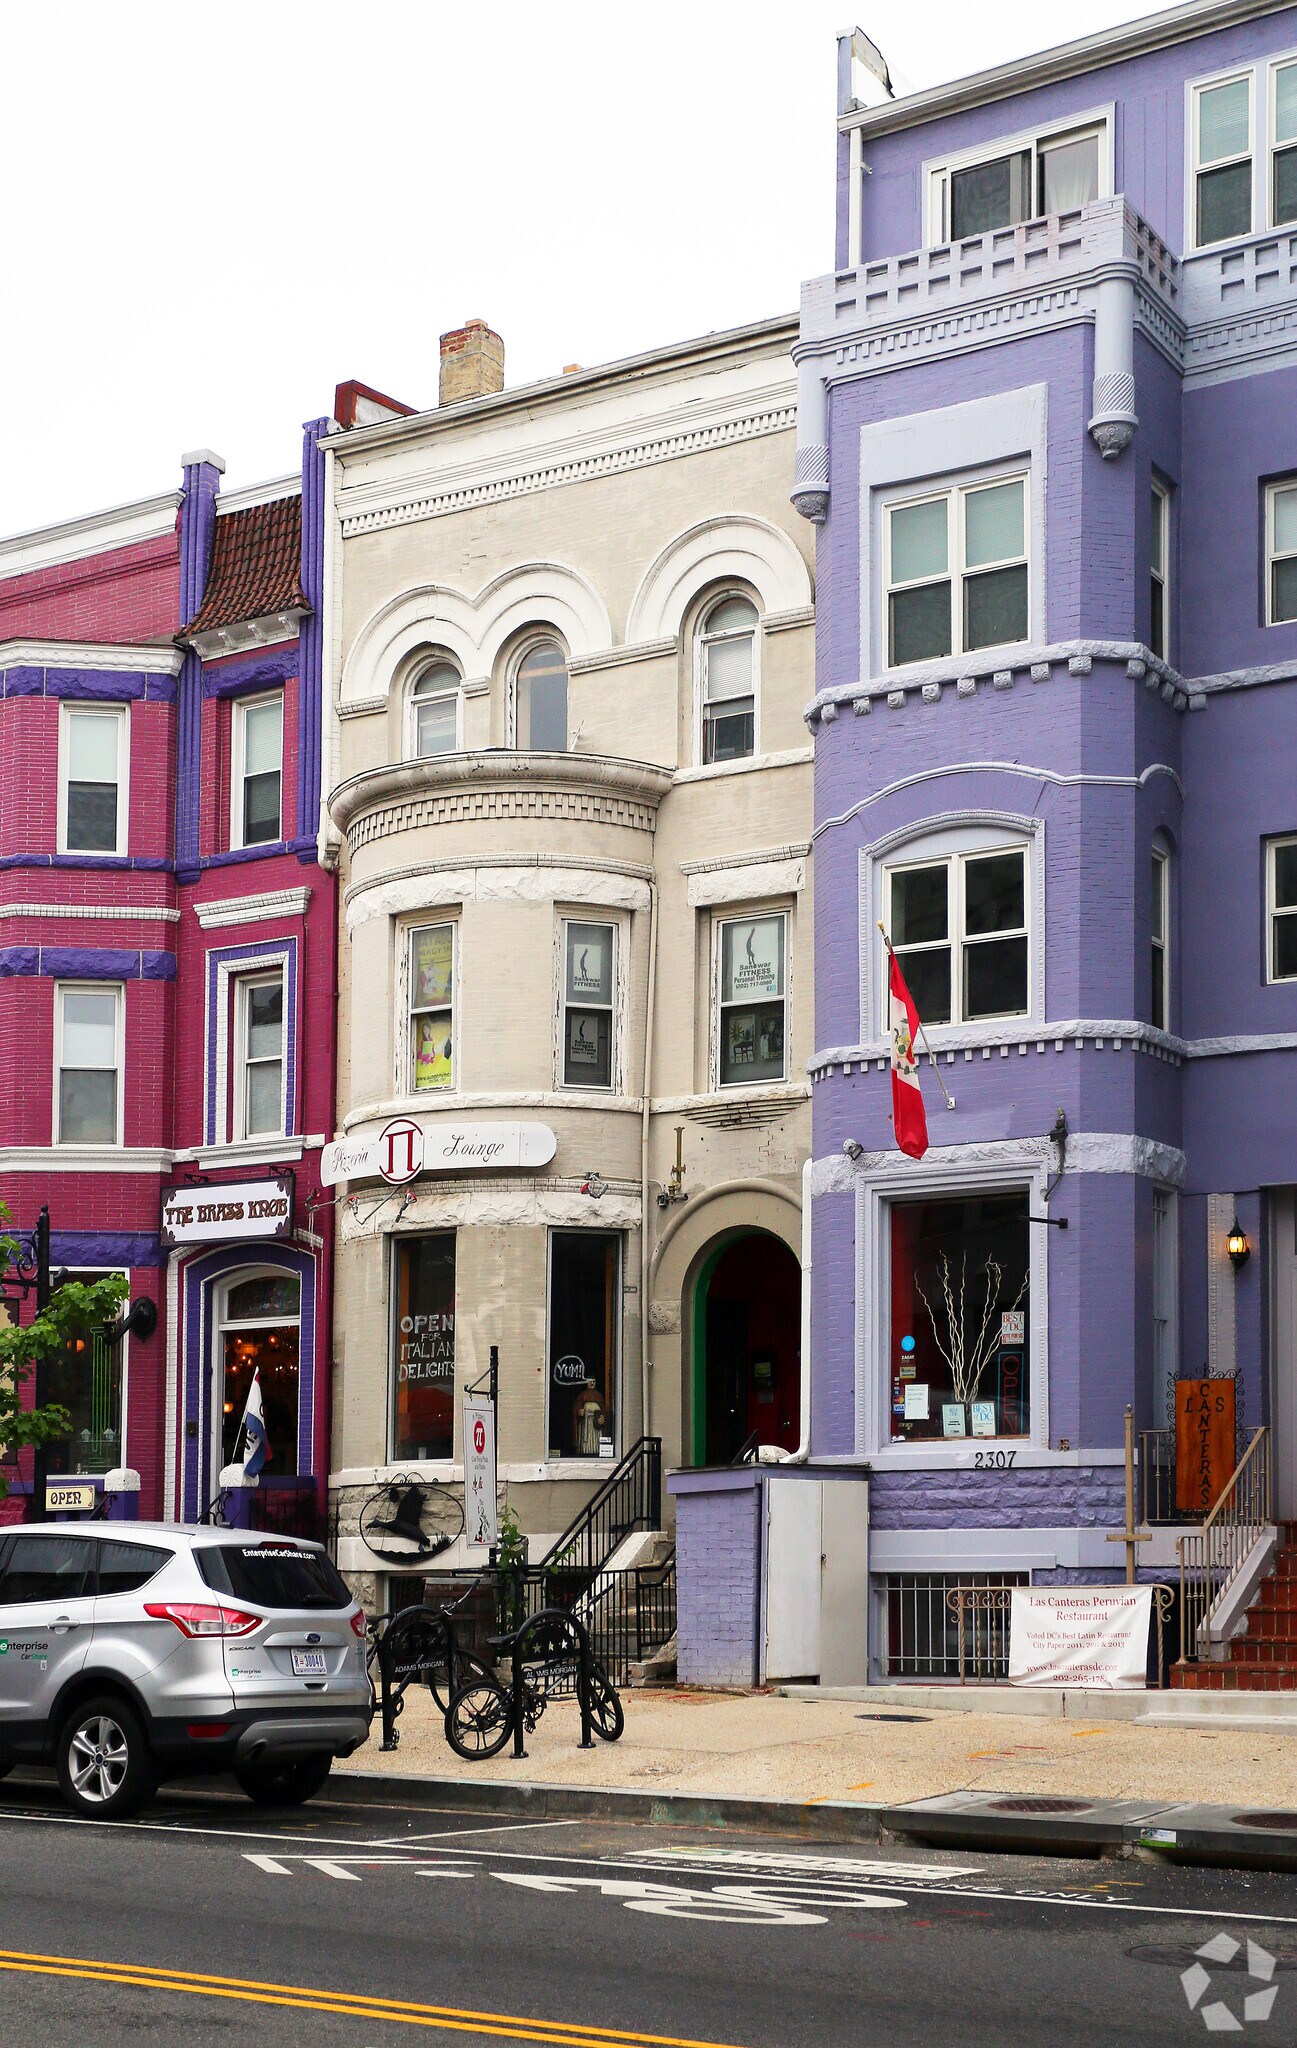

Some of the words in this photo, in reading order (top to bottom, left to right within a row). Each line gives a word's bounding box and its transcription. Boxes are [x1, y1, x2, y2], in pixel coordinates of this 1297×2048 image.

[734, 975, 755, 984] Personal
[756, 973, 775, 982] Training
[739, 967, 771, 977] FITNESS
[331, 1146, 369, 1173] Pizzeria
[443, 1134, 505, 1163] Lounge
[165, 1205, 193, 1227] THE
[197, 1202, 244, 1223] BRASS
[247, 1198, 288, 1219] KNOB
[400, 1314, 454, 1334] OPEN
[1002, 1313, 1023, 1322] BEST
[421, 1332, 442, 1343] FOR
[400, 1341, 455, 1361] ITALIAN
[398, 1360, 455, 1382] DELIGHTS
[557, 1363, 582, 1379] YUM!
[1002, 1355, 1020, 1435] OPEN
[973, 1404, 994, 1413] BEST
[1198, 1383, 1213, 1505] CANTERAS
[974, 1451, 1017, 1470] 2307
[50, 1491, 81, 1505] OPEN
[242, 1548, 316, 1561] EnterpriseCarShare.com
[1030, 1597, 1046, 1607] Las
[1048, 1596, 1090, 1607] Canteras
[1092, 1595, 1137, 1607] Peruvian
[1056, 1611, 1108, 1621] Restaurant
[1062, 1631, 1076, 1640] Best
[0, 1641, 49, 1652] enterprise
[1108, 1641, 1125, 1649] 2013
[394, 1664, 417, 1673] ADAMS
[417, 1660, 445, 1672] MORGAN
[549, 1665, 577, 1676] MORGAN
[1053, 1675, 1107, 1683] 202-265-178
[1014, 1889, 1134, 1902] ONLY
